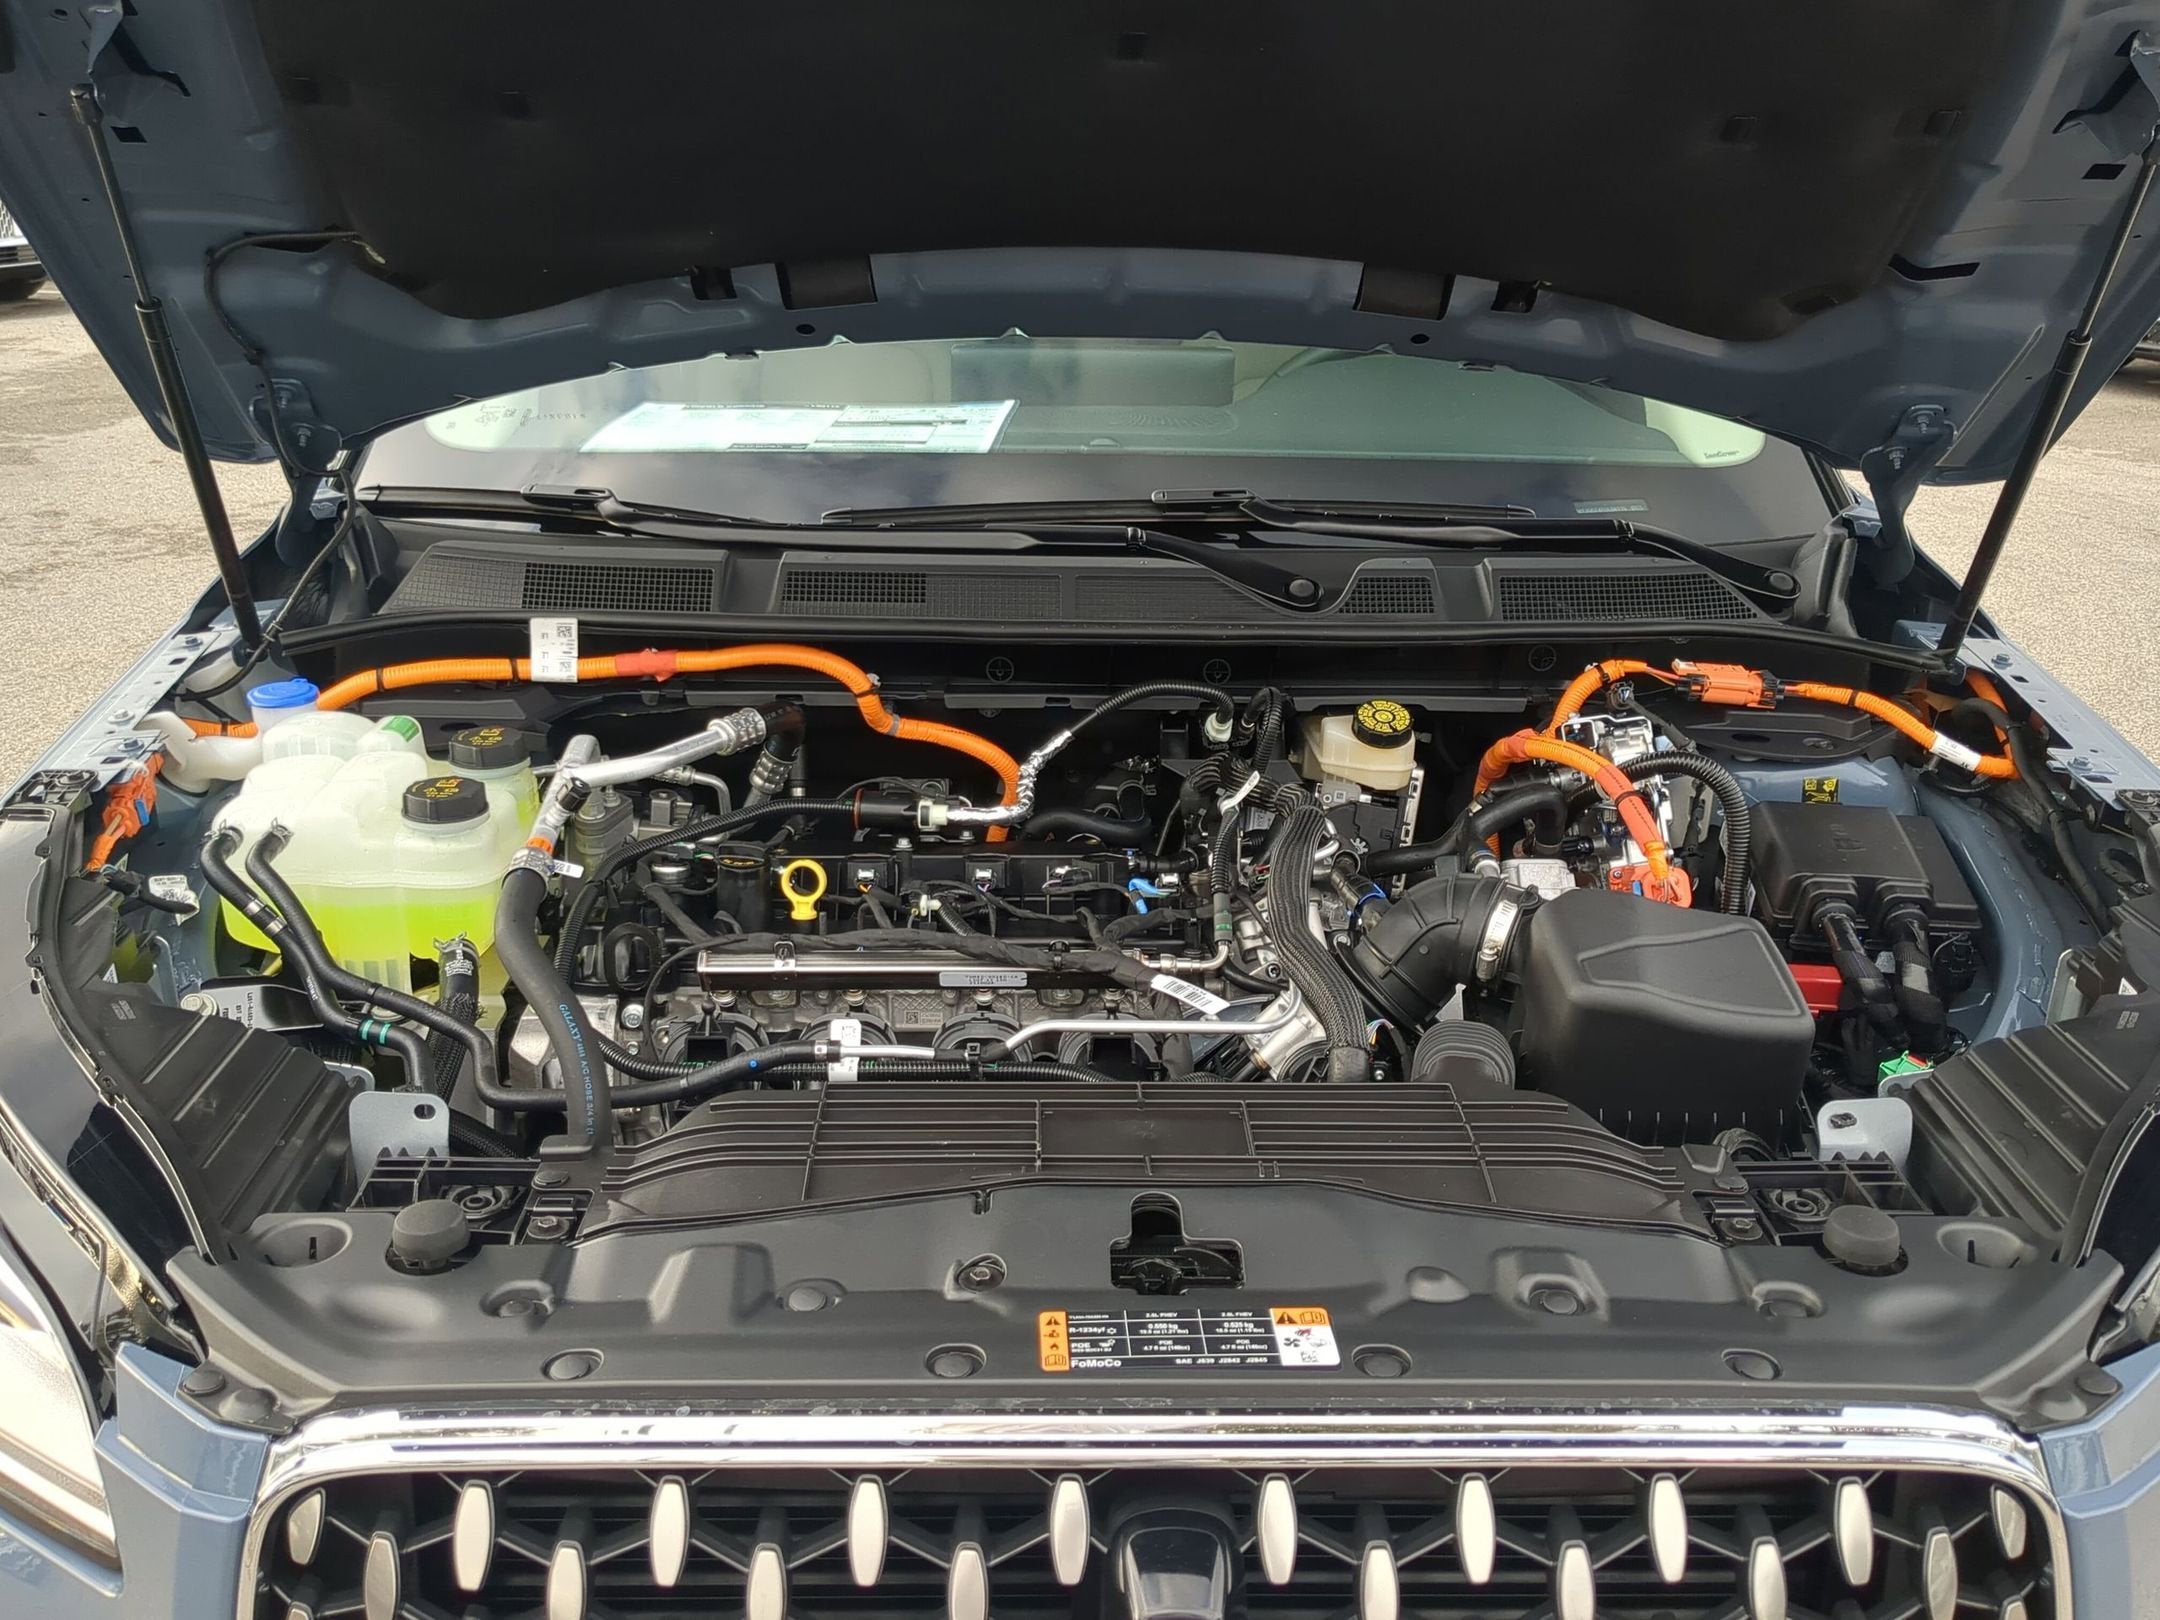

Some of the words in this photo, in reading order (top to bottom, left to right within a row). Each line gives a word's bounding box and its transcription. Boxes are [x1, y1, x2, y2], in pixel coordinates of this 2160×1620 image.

[583, 1076, 594, 1101] HOSE
[1069, 1326, 1106, 1334] R-1234yf
[1071, 1359, 1122, 1368] FoMoCo
